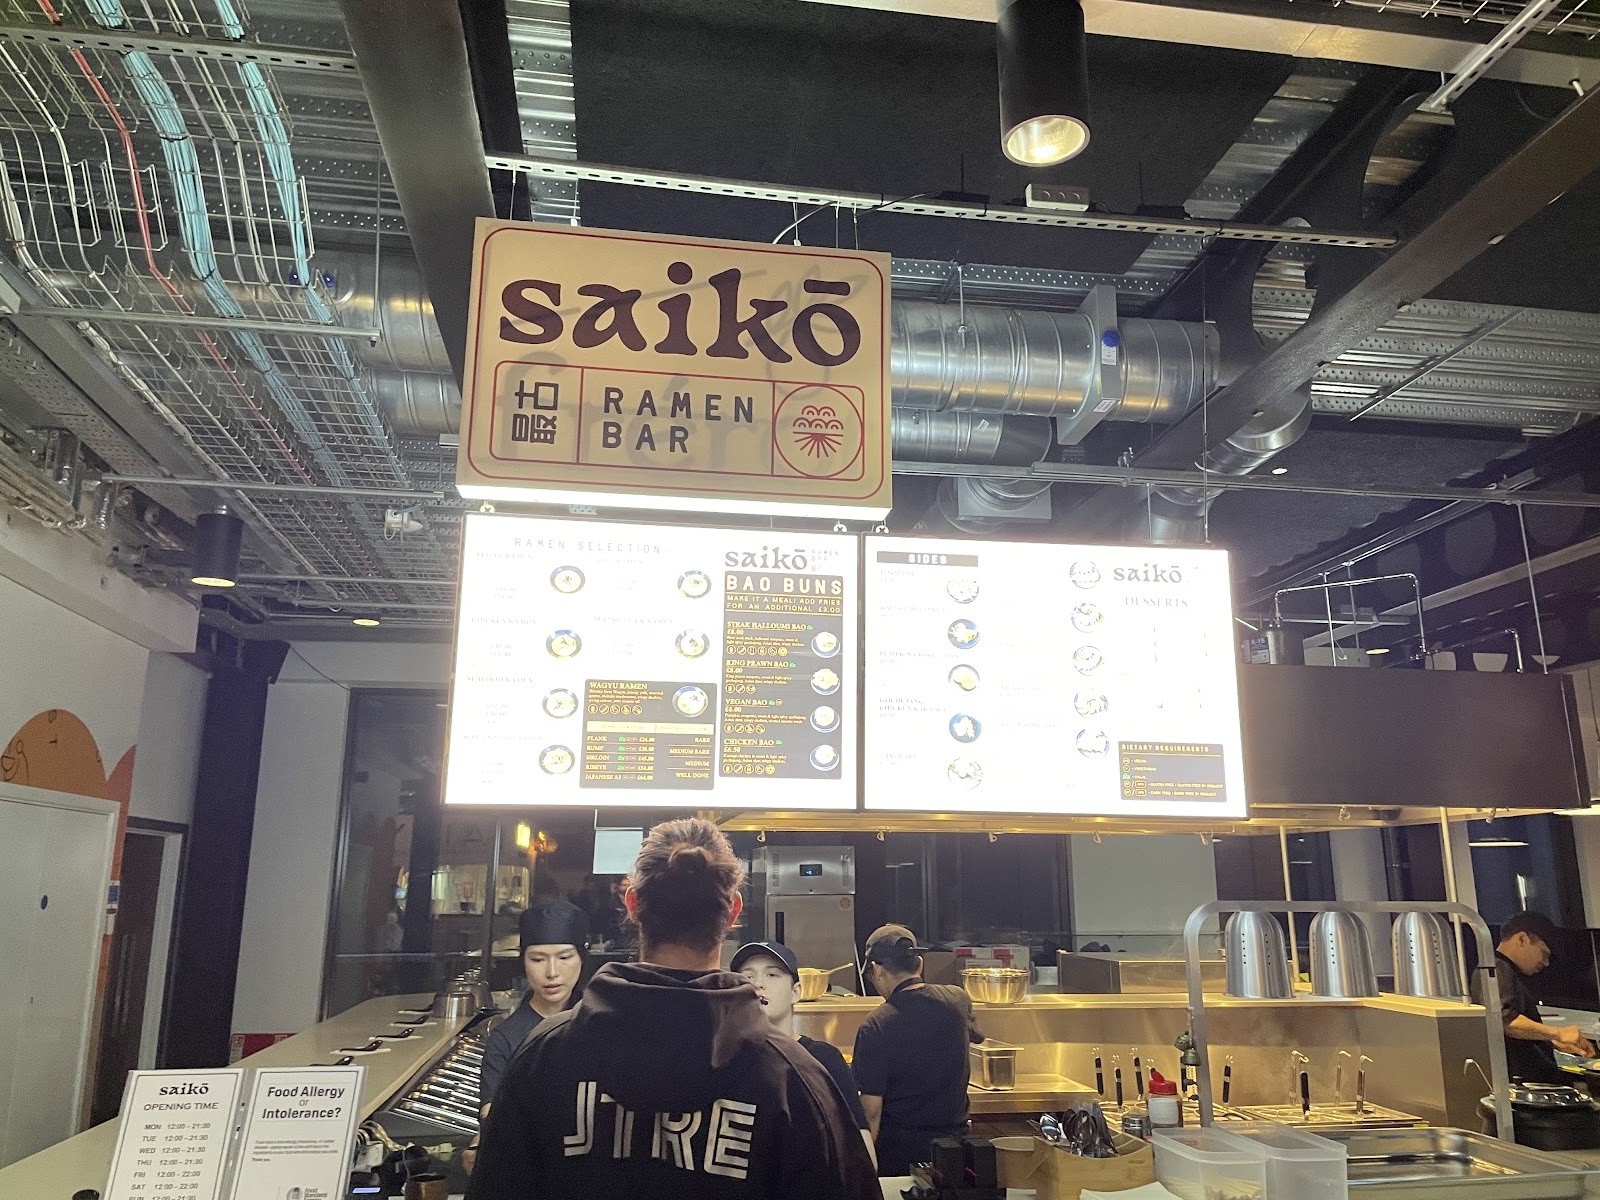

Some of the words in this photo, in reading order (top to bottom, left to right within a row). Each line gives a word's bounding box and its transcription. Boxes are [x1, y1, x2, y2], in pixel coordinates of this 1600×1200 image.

[500, 261, 861, 366] saikō
[604, 387, 753, 424] RAMEN
[602, 421, 689, 454] BAR
[515, 538, 565, 549] RAMEN
[578, 541, 660, 554] SELECTION
[725, 545, 807, 570] saikō
[908, 553, 947, 565] SIDES
[1113, 563, 1182, 584] saikō
[726, 575, 770, 591] BAO
[783, 578, 842, 595] BUNS
[765, 604, 813, 612] ADDITIONAL
[727, 621, 751, 629] STEAK
[752, 622, 791, 630] HALLOUMI
[746, 660, 773, 668] PRAWN
[589, 682, 619, 690] WAGYU
[620, 682, 648, 690] RAMEN
[725, 698, 751, 706] VEGAN
[724, 738, 758, 746] CHICKEN
[159, 1083, 209, 1096] saikō
[267, 1086, 298, 1097] Food
[300, 1086, 345, 1099] Allergy
[144, 1102, 191, 1111] OPENING
[194, 1102, 219, 1110] TIME
[299, 1099, 310, 1107] or
[262, 1107, 342, 1119] Intolerance?
